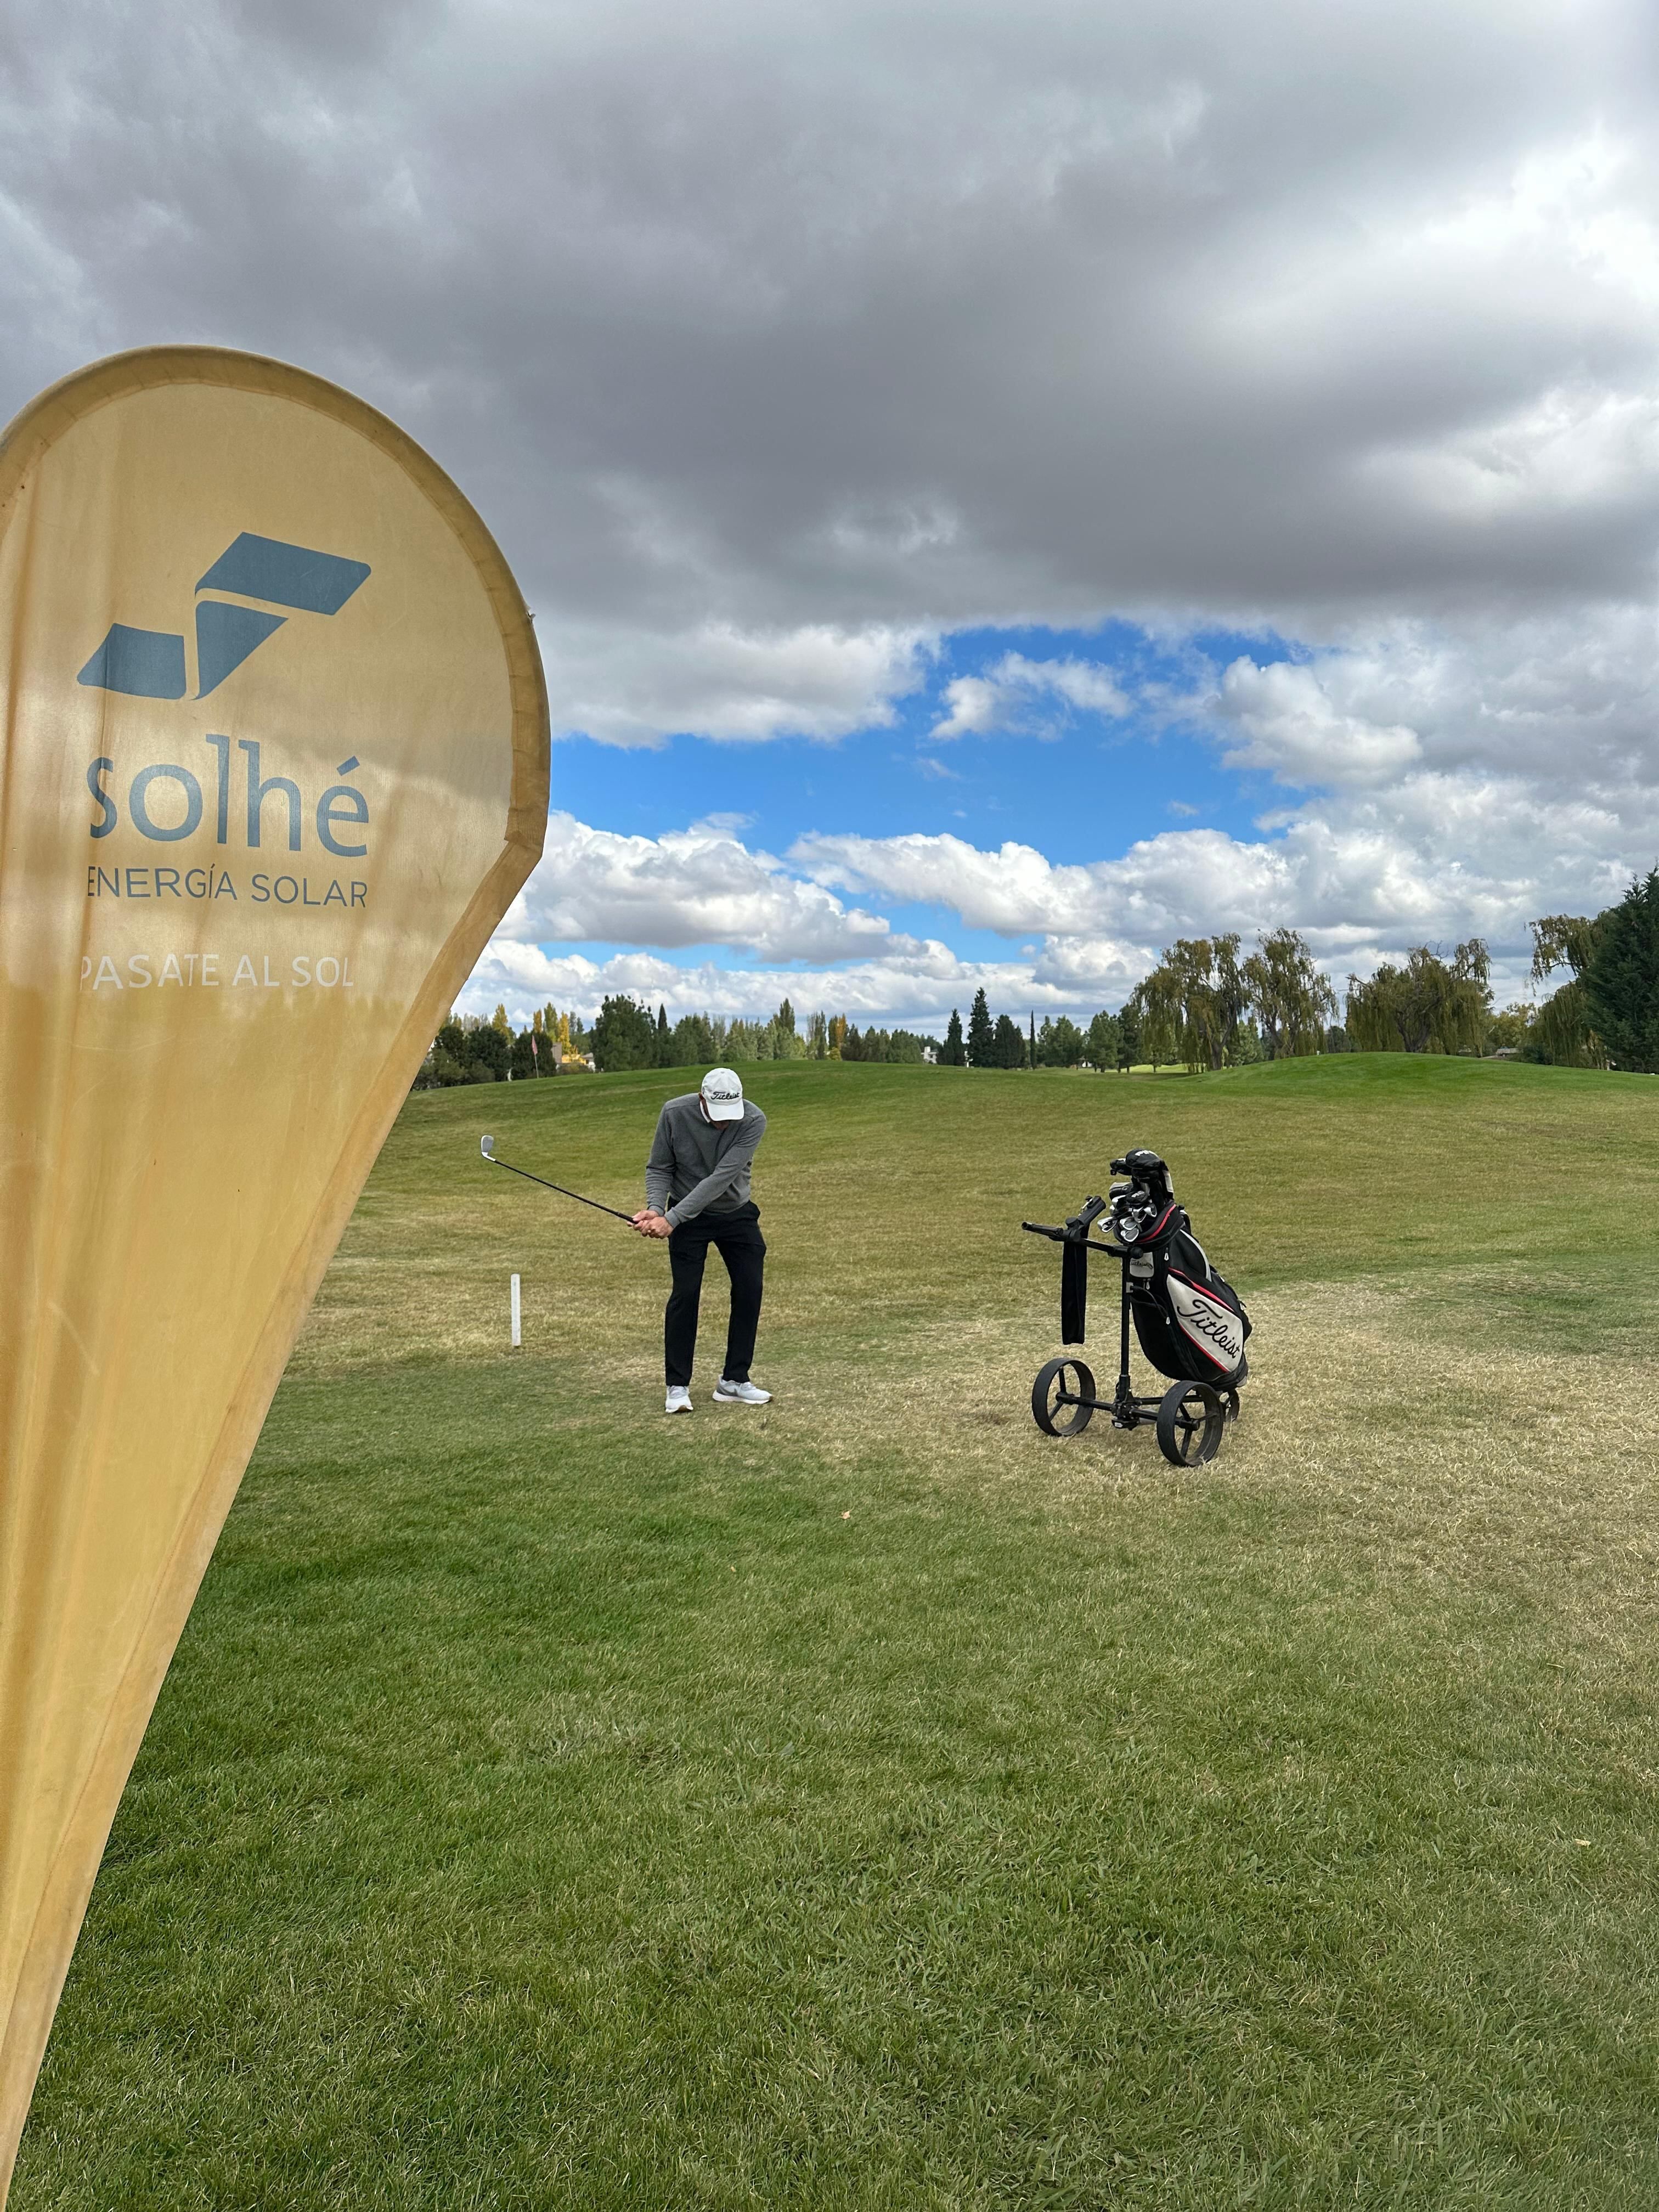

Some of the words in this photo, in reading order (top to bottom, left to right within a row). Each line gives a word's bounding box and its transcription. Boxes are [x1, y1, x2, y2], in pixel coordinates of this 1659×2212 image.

[87, 733, 369, 857] solhé
[88, 863, 238, 900] ENERGÍA
[251, 873, 368, 907] SOLAR
[80, 953, 219, 991] PASATE
[232, 955, 280, 986] AL
[291, 956, 353, 987] SOL
[1177, 1299, 1240, 1358] Titleist
